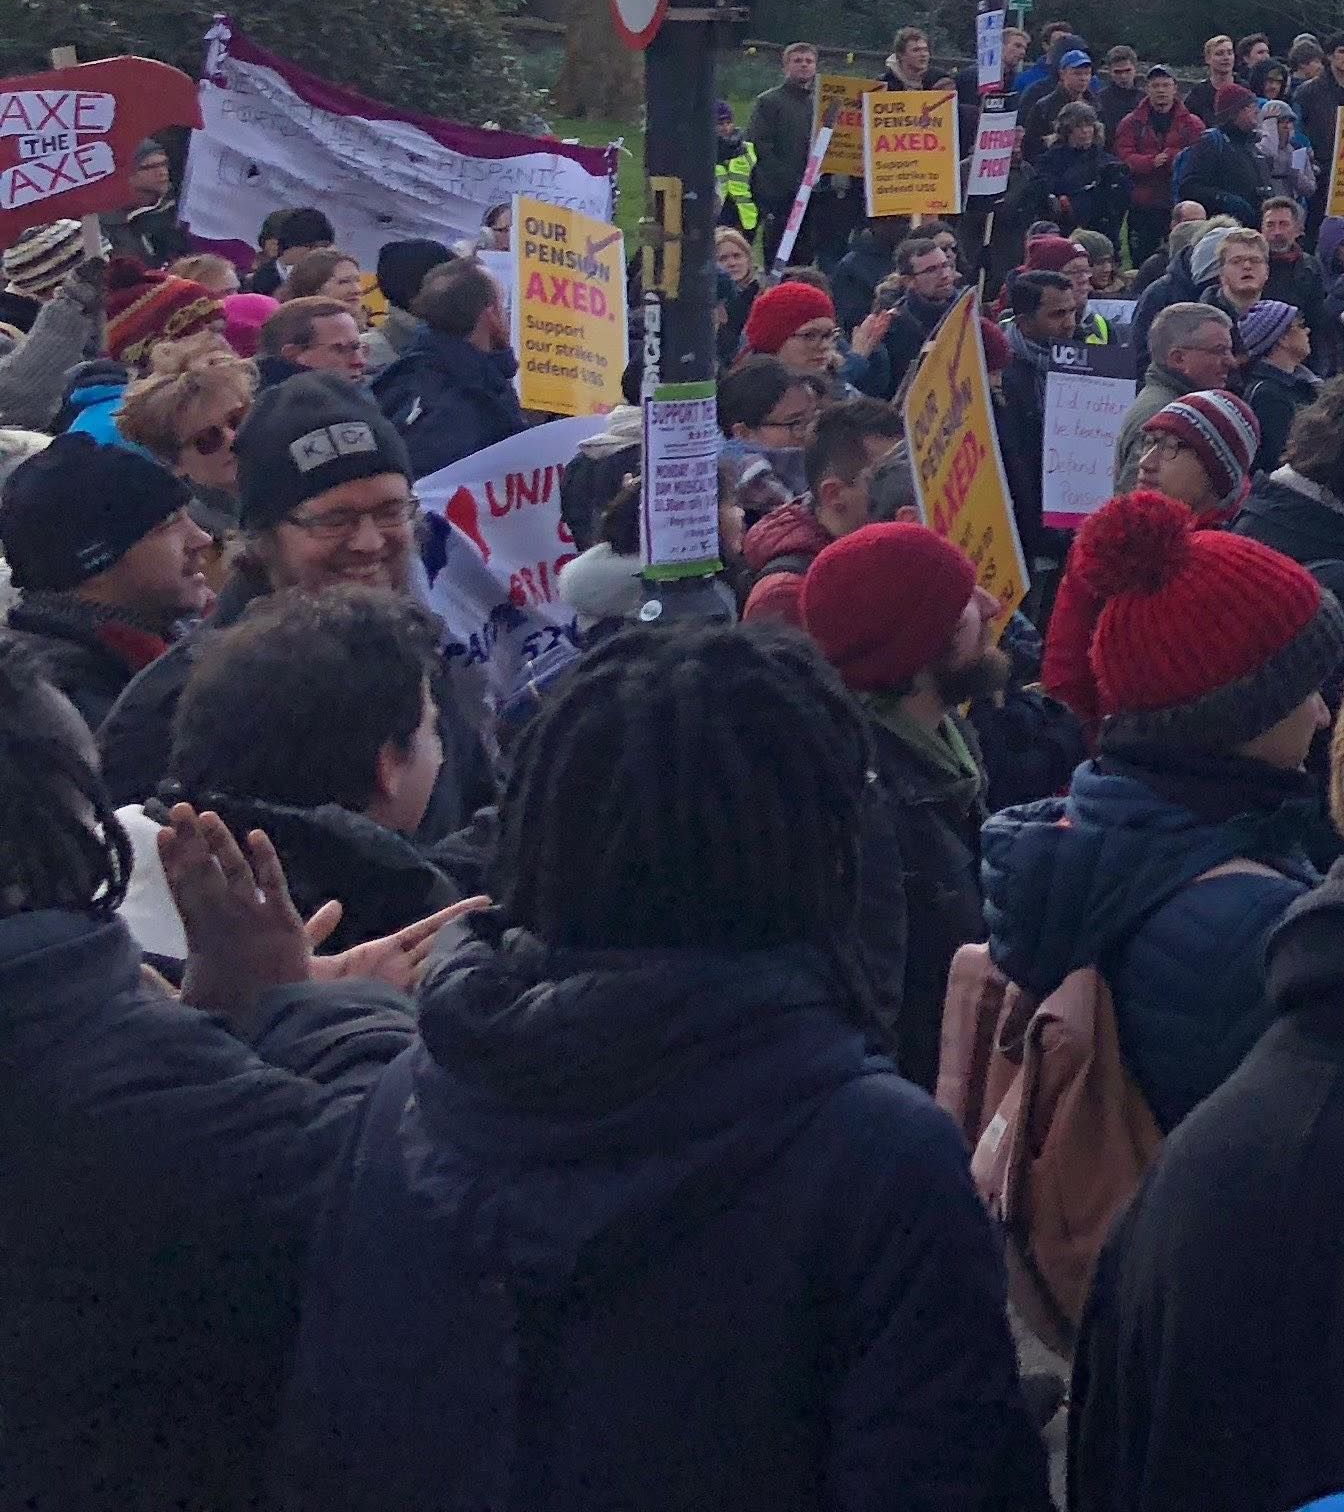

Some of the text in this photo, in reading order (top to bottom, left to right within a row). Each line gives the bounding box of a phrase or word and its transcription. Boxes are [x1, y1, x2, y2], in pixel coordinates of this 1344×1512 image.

[0, 94, 106, 130] AXE
[874, 102, 905, 115] OUR
[874, 116, 943, 128] PENSION
[24, 134, 69, 155] THE
[875, 133, 946, 153] AXED.
[10, 146, 107, 203] AXE
[525, 217, 567, 243] OUR
[525, 240, 610, 282] PENSION
[525, 272, 615, 321] AXED.
[526, 315, 584, 338] Support
[525, 339, 552, 353] our
[1052, 345, 1088, 366] UCU
[527, 358, 578, 379] defend
[1056, 384, 1078, 409] I'd
